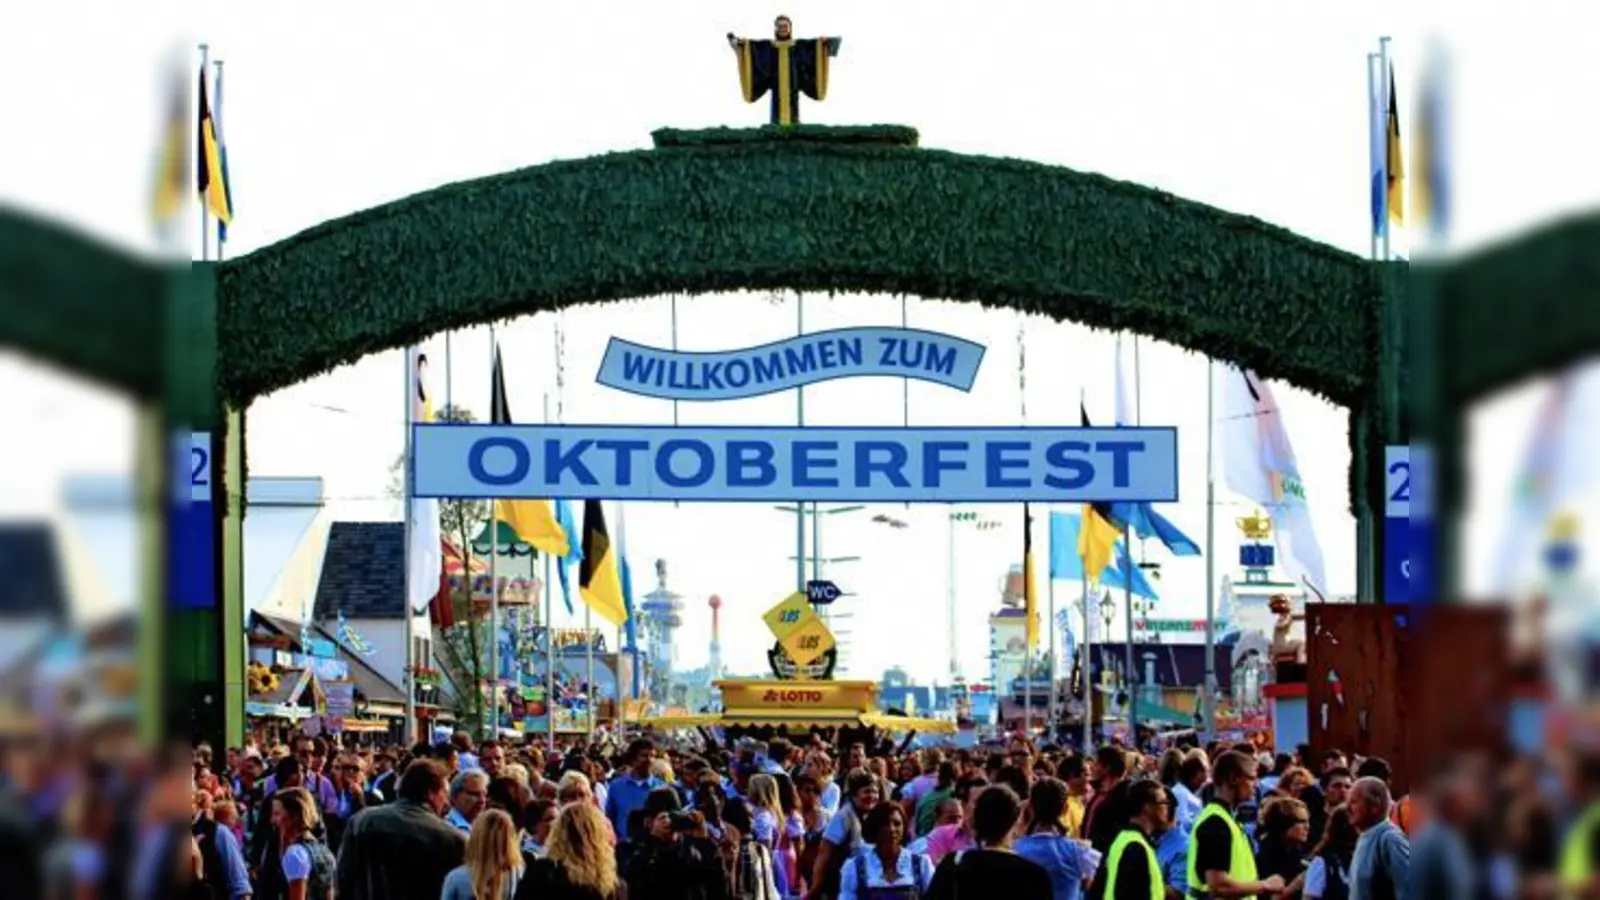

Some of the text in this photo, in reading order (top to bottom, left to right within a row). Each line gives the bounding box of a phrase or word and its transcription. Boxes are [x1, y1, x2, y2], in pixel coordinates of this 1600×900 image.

[622, 336, 958, 391] WILLKOMMEN ZUM
[191, 447, 208, 485] 2
[467, 435, 1147, 489] OKTOBERFEST
[809, 586, 836, 599] WC
[780, 689, 823, 703] LOTTO
